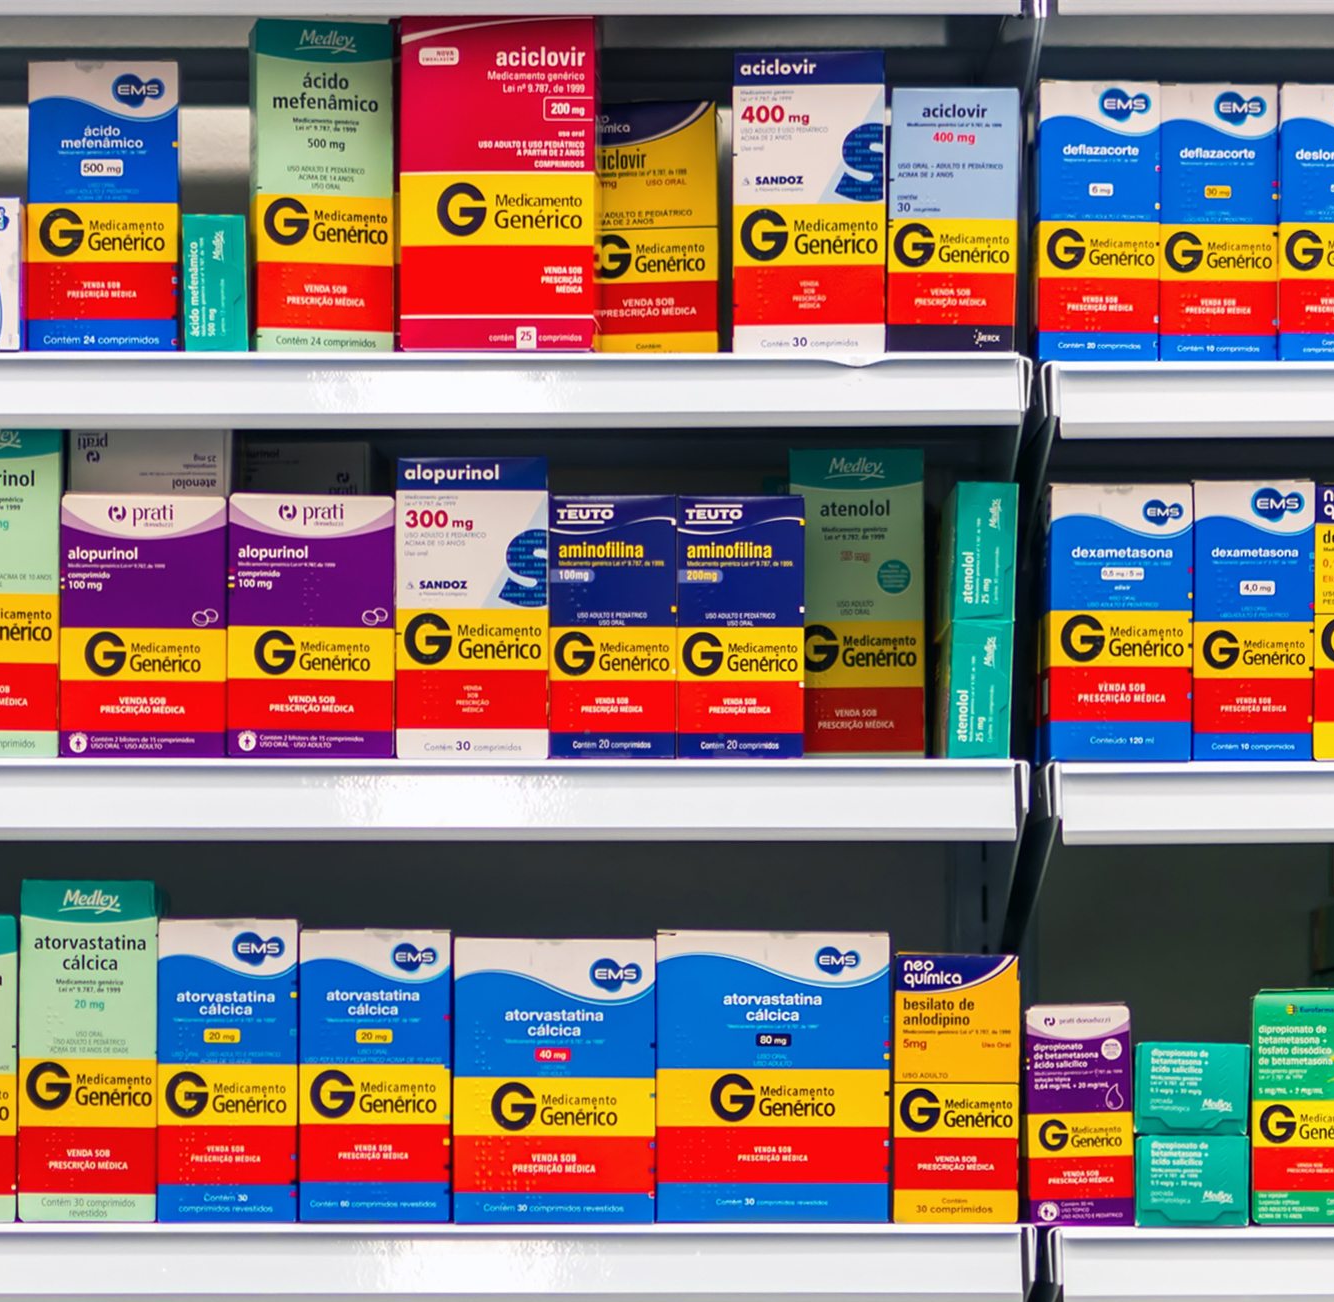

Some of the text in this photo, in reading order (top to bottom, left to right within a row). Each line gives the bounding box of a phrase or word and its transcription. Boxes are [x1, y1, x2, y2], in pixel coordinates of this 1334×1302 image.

[495, 46, 586, 67] aciclovir
[740, 58, 817, 76] aciclovir
[487, 70, 585, 83] Medicamento genérico
[117, 84, 160, 96] EMS
[551, 103, 585, 117] 200 mg
[83, 125, 121, 137] ácido
[61, 136, 144, 149] mefenâmico
[1062, 143, 1140, 156] deflazacorte
[43, 334, 160, 346] Contém 24 comprimidos
[132, 504, 174, 527] prati
[556, 508, 614, 520] TEUTO
[558, 541, 644, 559] aminofilina
[686, 569, 718, 583] 200mg
[961, 551, 975, 604] atenolol
[1109, 625, 1184, 642] Medicamento
[1108, 637, 1185, 658] Genérico
[903, 997, 975, 1011] besilato de
[903, 1012, 970, 1029] anlodipino
[902, 1038, 928, 1051] 5mg
